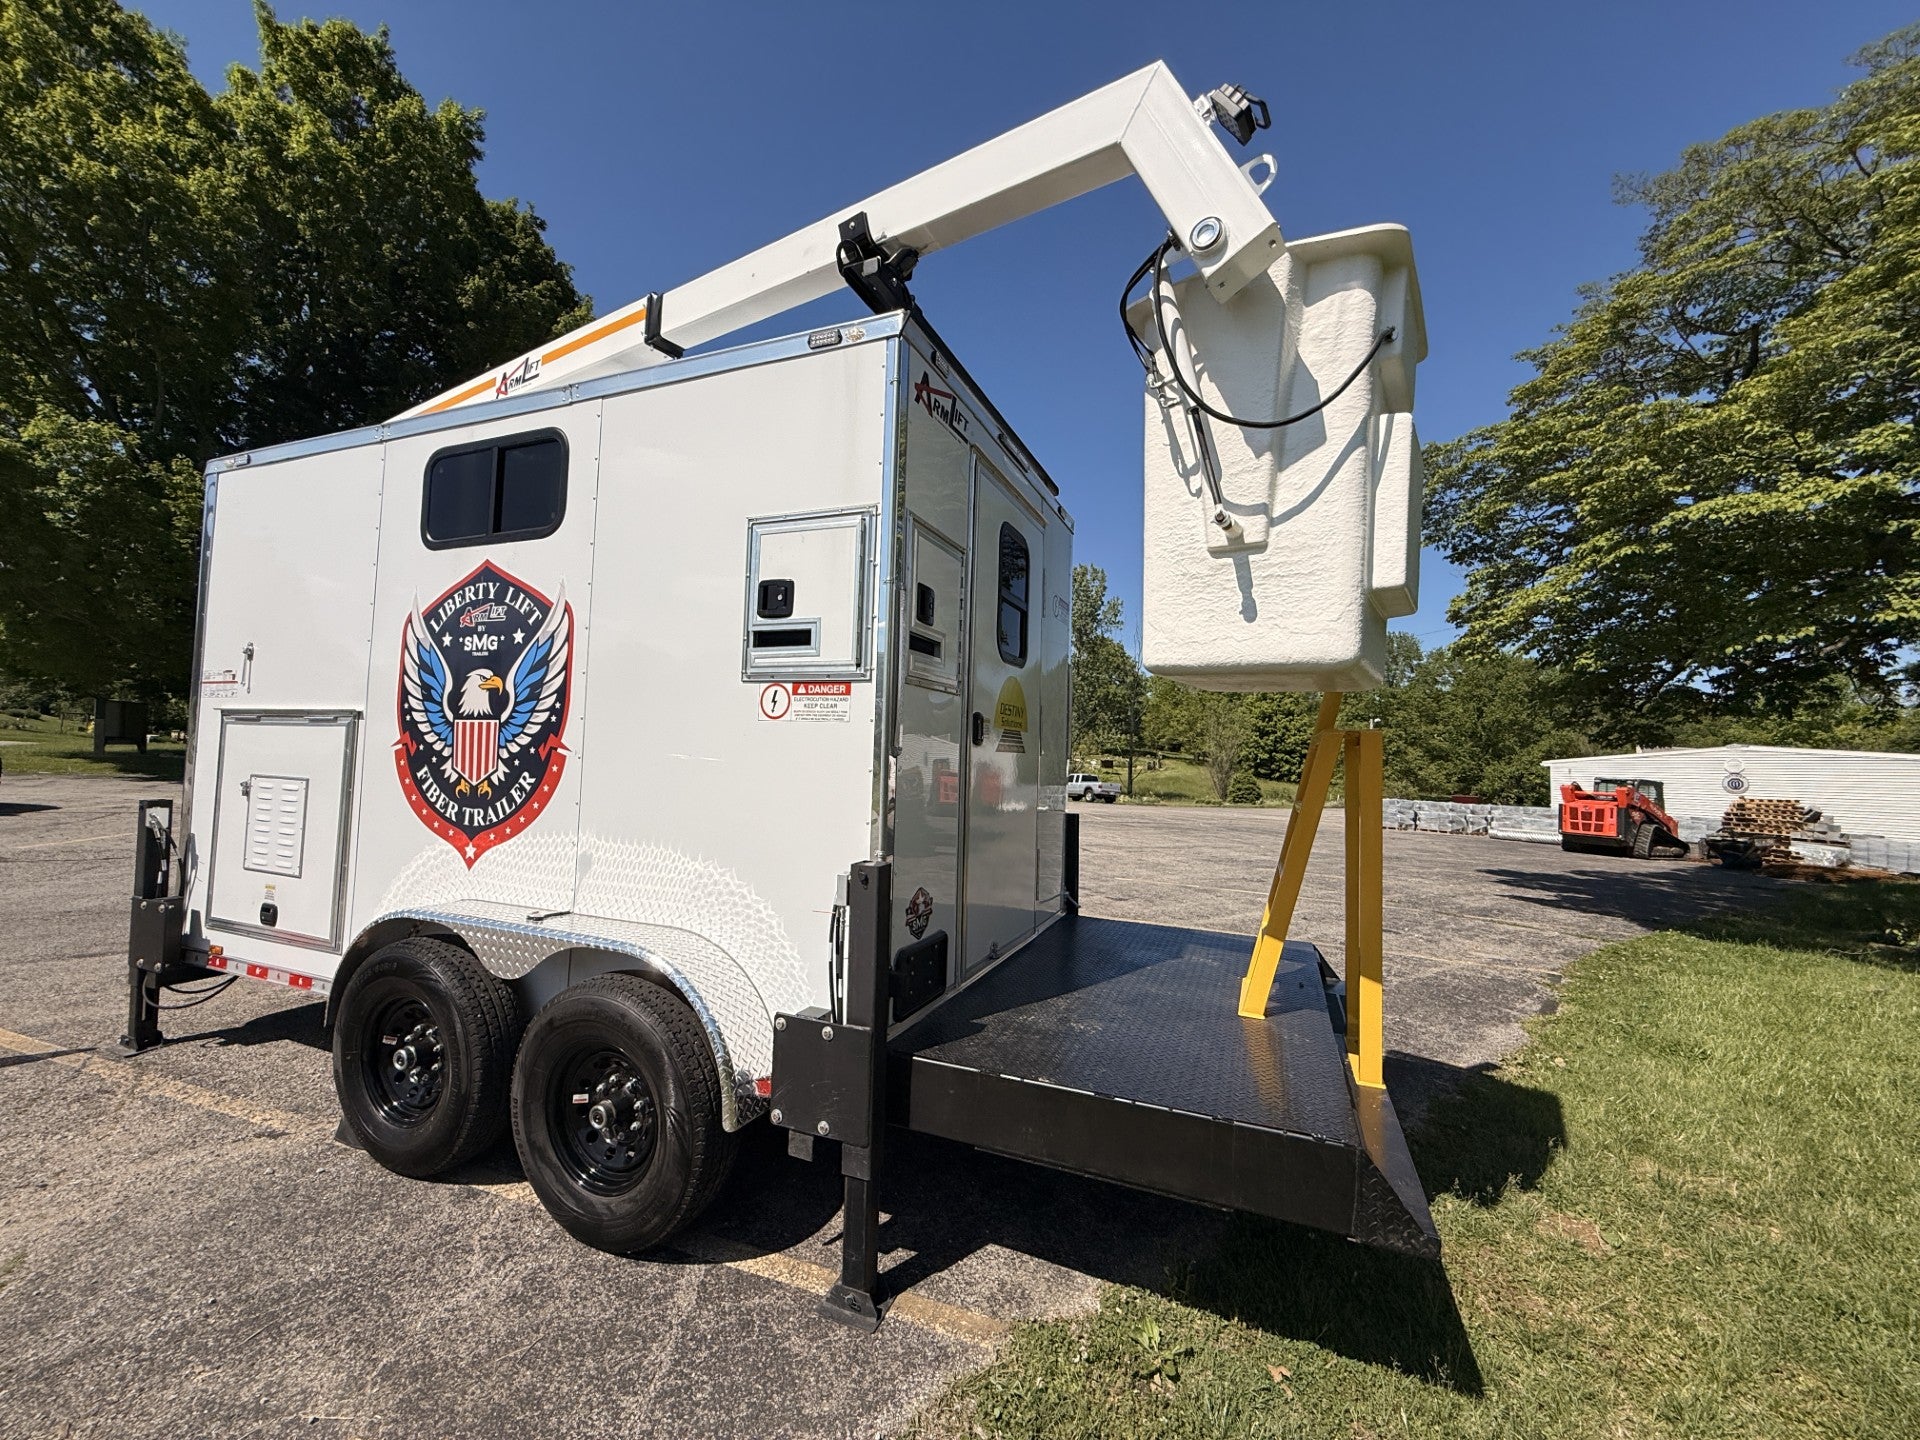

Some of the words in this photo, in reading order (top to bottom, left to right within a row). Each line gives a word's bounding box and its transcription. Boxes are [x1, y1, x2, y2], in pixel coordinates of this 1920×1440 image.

[429, 582, 500, 633] LIBERTY
[504, 586, 542, 626] LIFT
[463, 633, 499, 651] SMG
[808, 684, 846, 694] DANGER
[1000, 702, 1025, 718] DESTINY
[416, 764, 459, 823] FIBER
[462, 771, 537, 827] TRAILER
